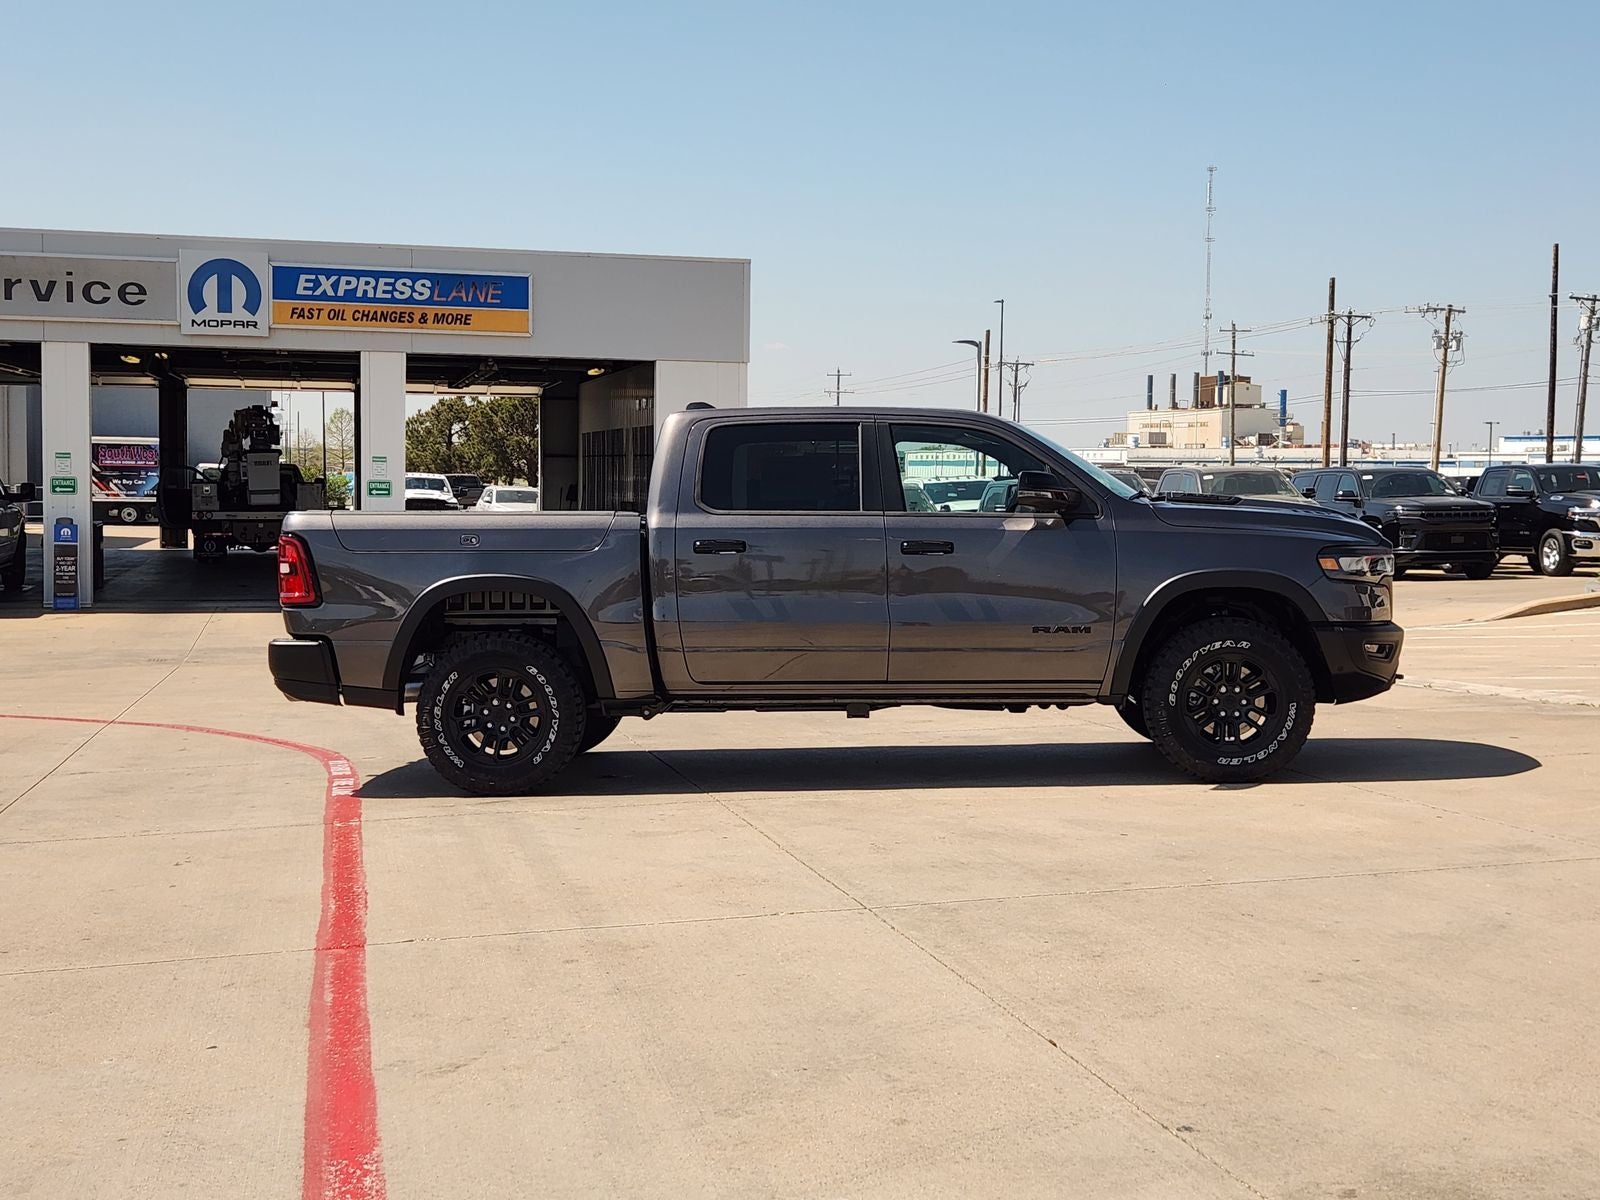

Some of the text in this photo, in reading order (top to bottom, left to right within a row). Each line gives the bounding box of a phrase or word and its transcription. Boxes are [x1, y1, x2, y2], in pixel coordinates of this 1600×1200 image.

[3, 271, 148, 306] rvice
[191, 319, 258, 329] MOPAR
[290, 307, 472, 326] FAST OIL CHANGES & MORE
[1031, 625, 1092, 634] RAM
[434, 671, 465, 768] WRANGLER
[1216, 702, 1297, 766] WRANGLER
